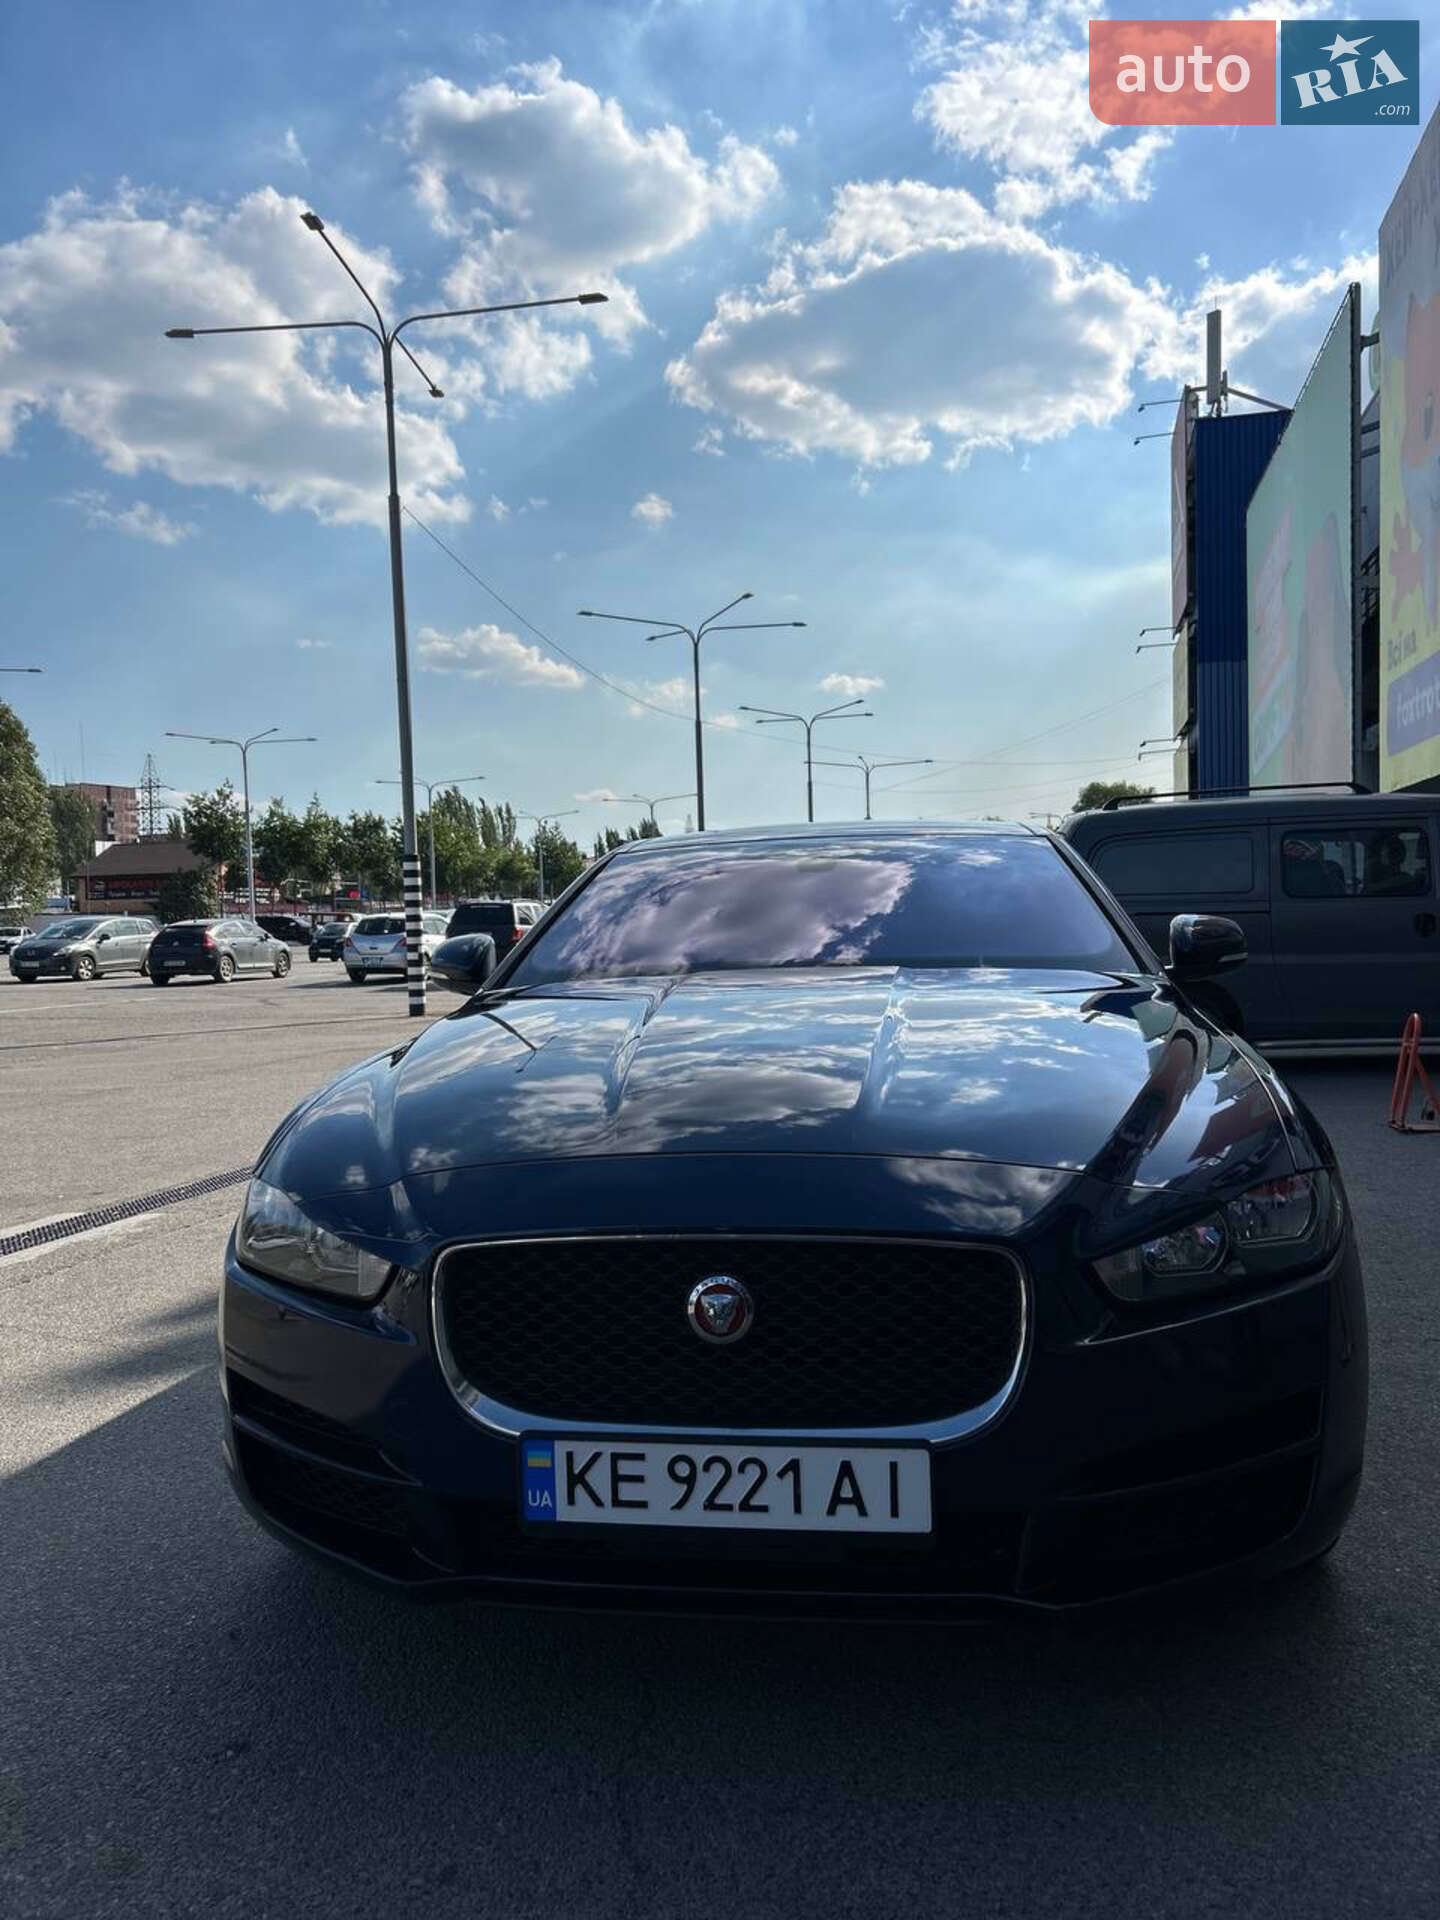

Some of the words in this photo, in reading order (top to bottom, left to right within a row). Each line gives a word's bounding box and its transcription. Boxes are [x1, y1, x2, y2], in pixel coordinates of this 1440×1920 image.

[528, 1489, 553, 1508] UA
[565, 1450, 649, 1509] KE
[667, 1454, 802, 1515] 9221
